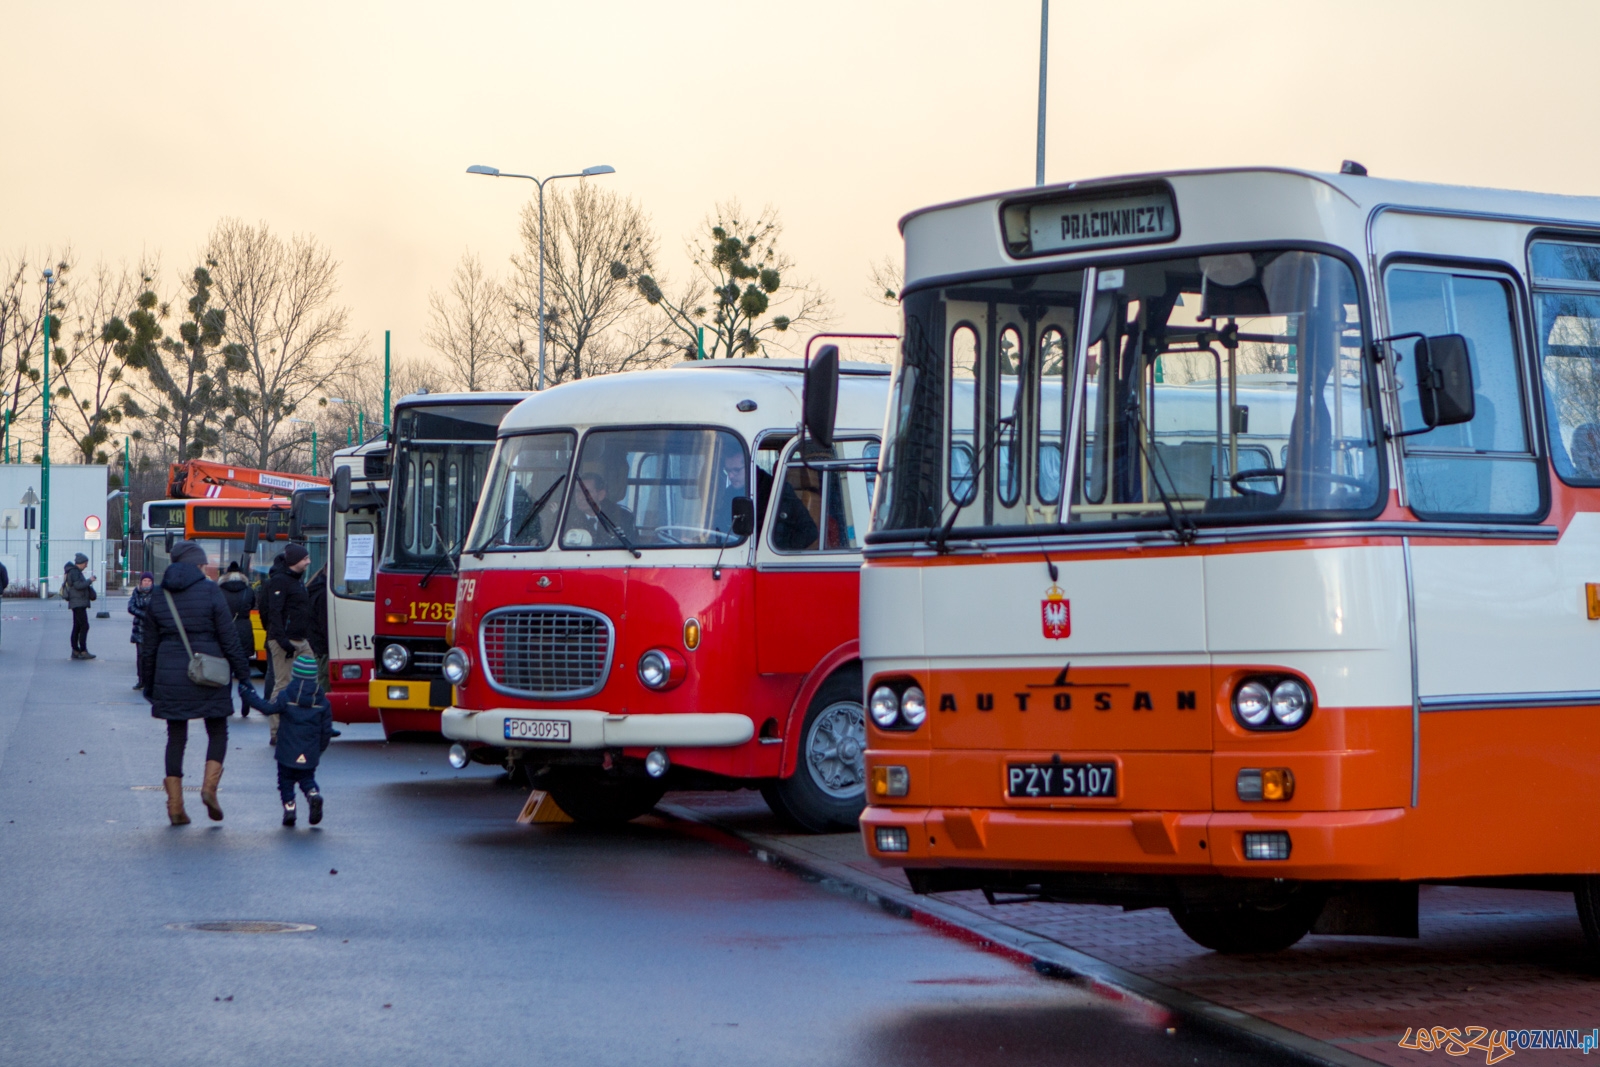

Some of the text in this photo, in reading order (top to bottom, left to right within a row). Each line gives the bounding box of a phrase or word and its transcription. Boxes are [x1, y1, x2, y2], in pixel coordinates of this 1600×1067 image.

[1061, 206, 1165, 240] PRACOWNICZY
[261, 475, 293, 488] bumar
[409, 602, 455, 620] 1735
[939, 691, 1197, 711] AUTOSAN
[511, 721, 567, 738] PO 3095T
[1009, 768, 1113, 793] PZY 5107
